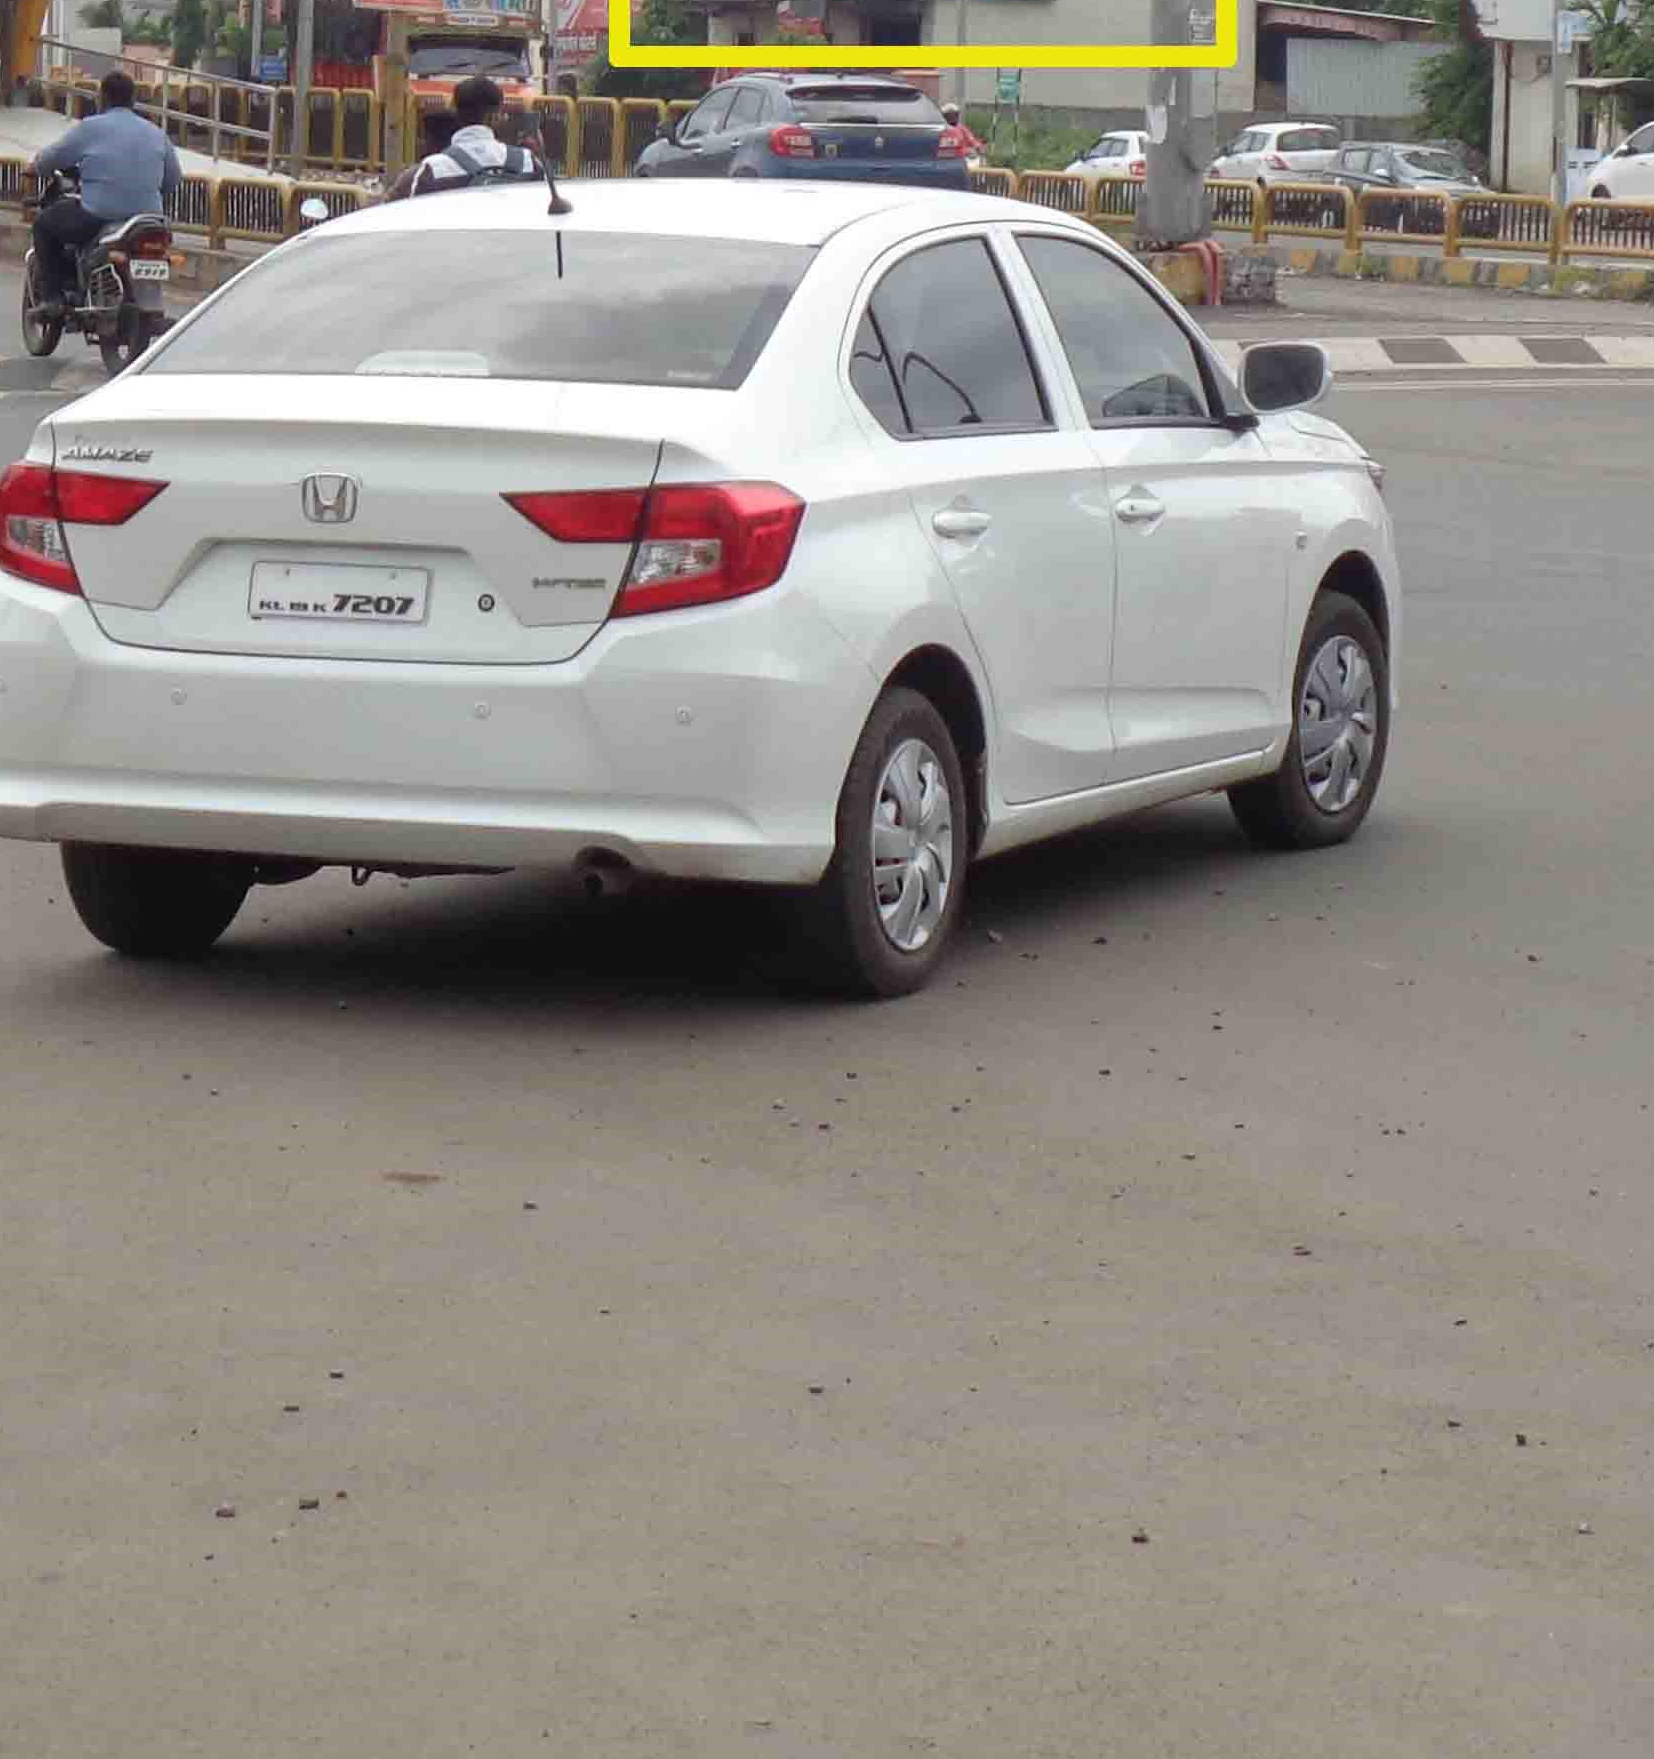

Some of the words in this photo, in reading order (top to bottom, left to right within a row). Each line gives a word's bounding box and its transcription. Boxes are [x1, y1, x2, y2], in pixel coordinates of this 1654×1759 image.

[259, 600, 283, 611] KL
[313, 602, 327, 612] K
[333, 594, 415, 615] 7207
